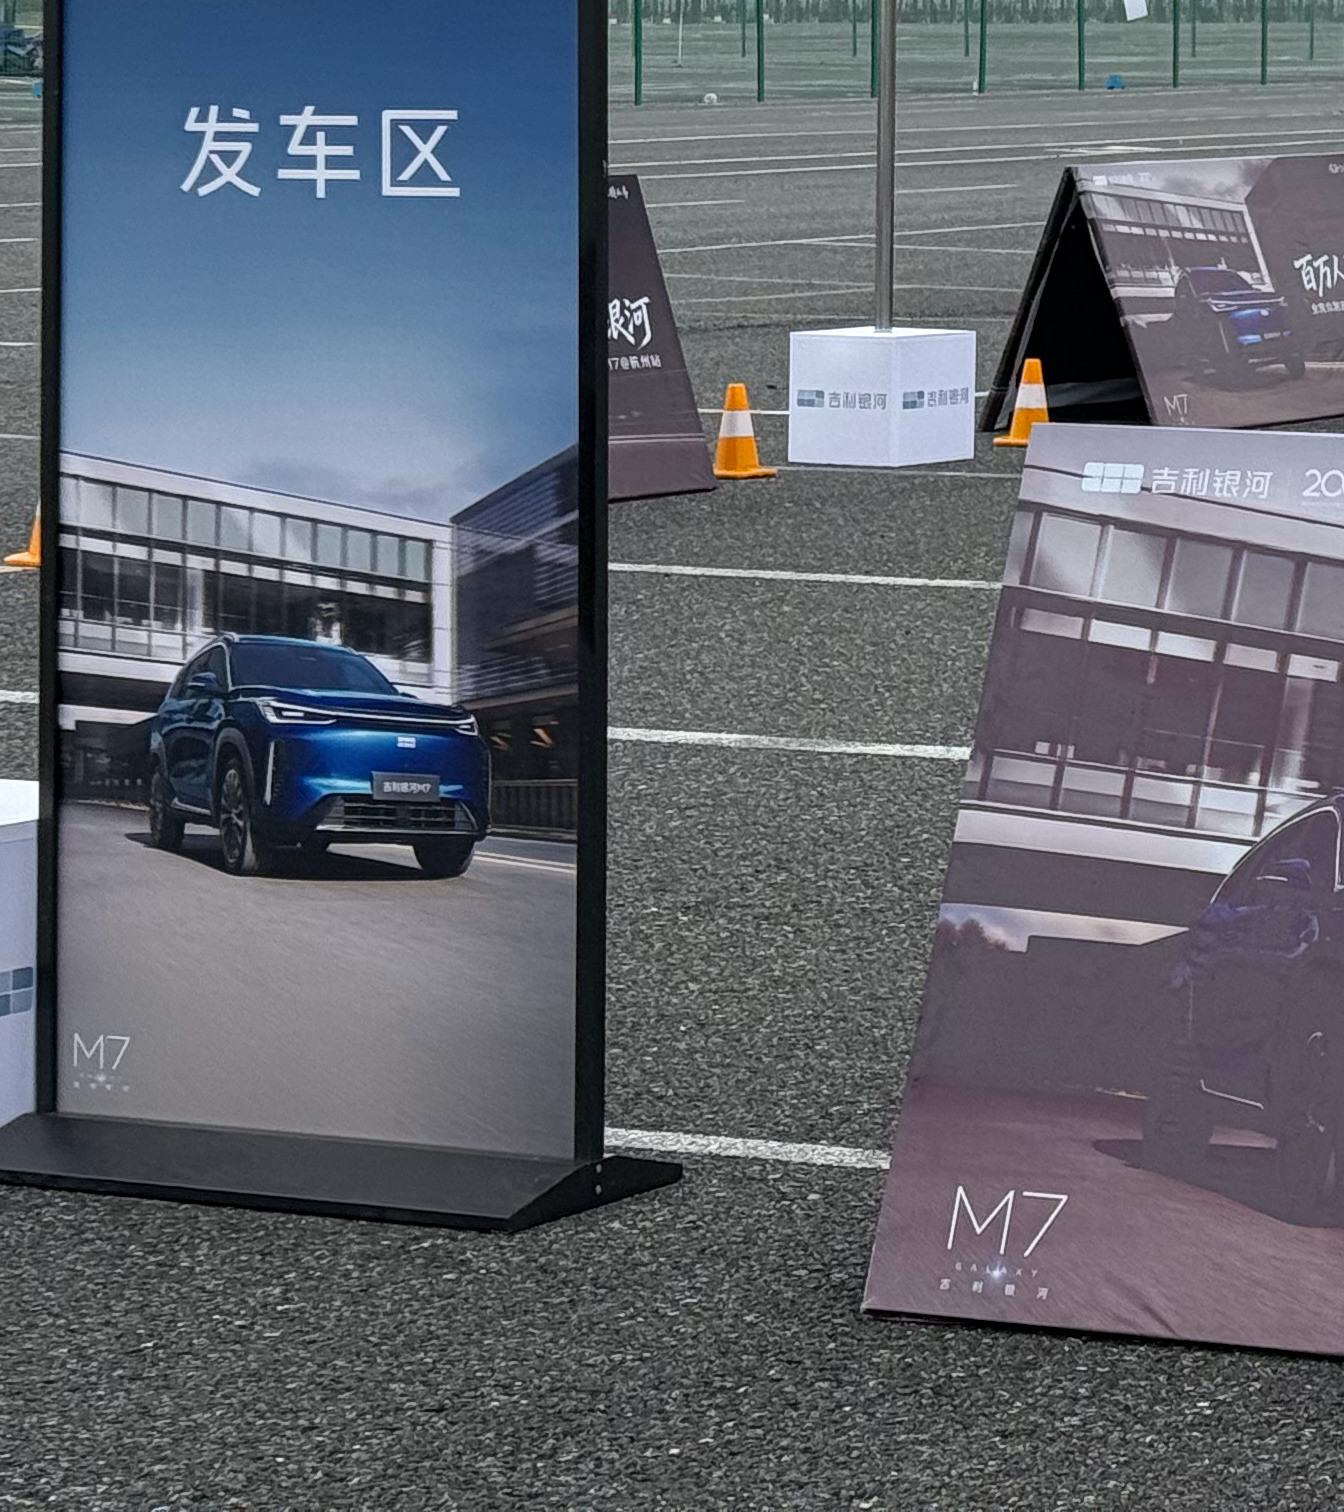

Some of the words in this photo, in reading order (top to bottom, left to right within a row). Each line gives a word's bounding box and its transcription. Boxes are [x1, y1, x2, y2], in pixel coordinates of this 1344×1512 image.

[180, 105, 461, 199] 发车区
[828, 392, 888, 410] 吉利银河
[1151, 467, 1273, 499] 吉利银河
[73, 1032, 131, 1070] M7
[946, 1185, 1069, 1258] M7
